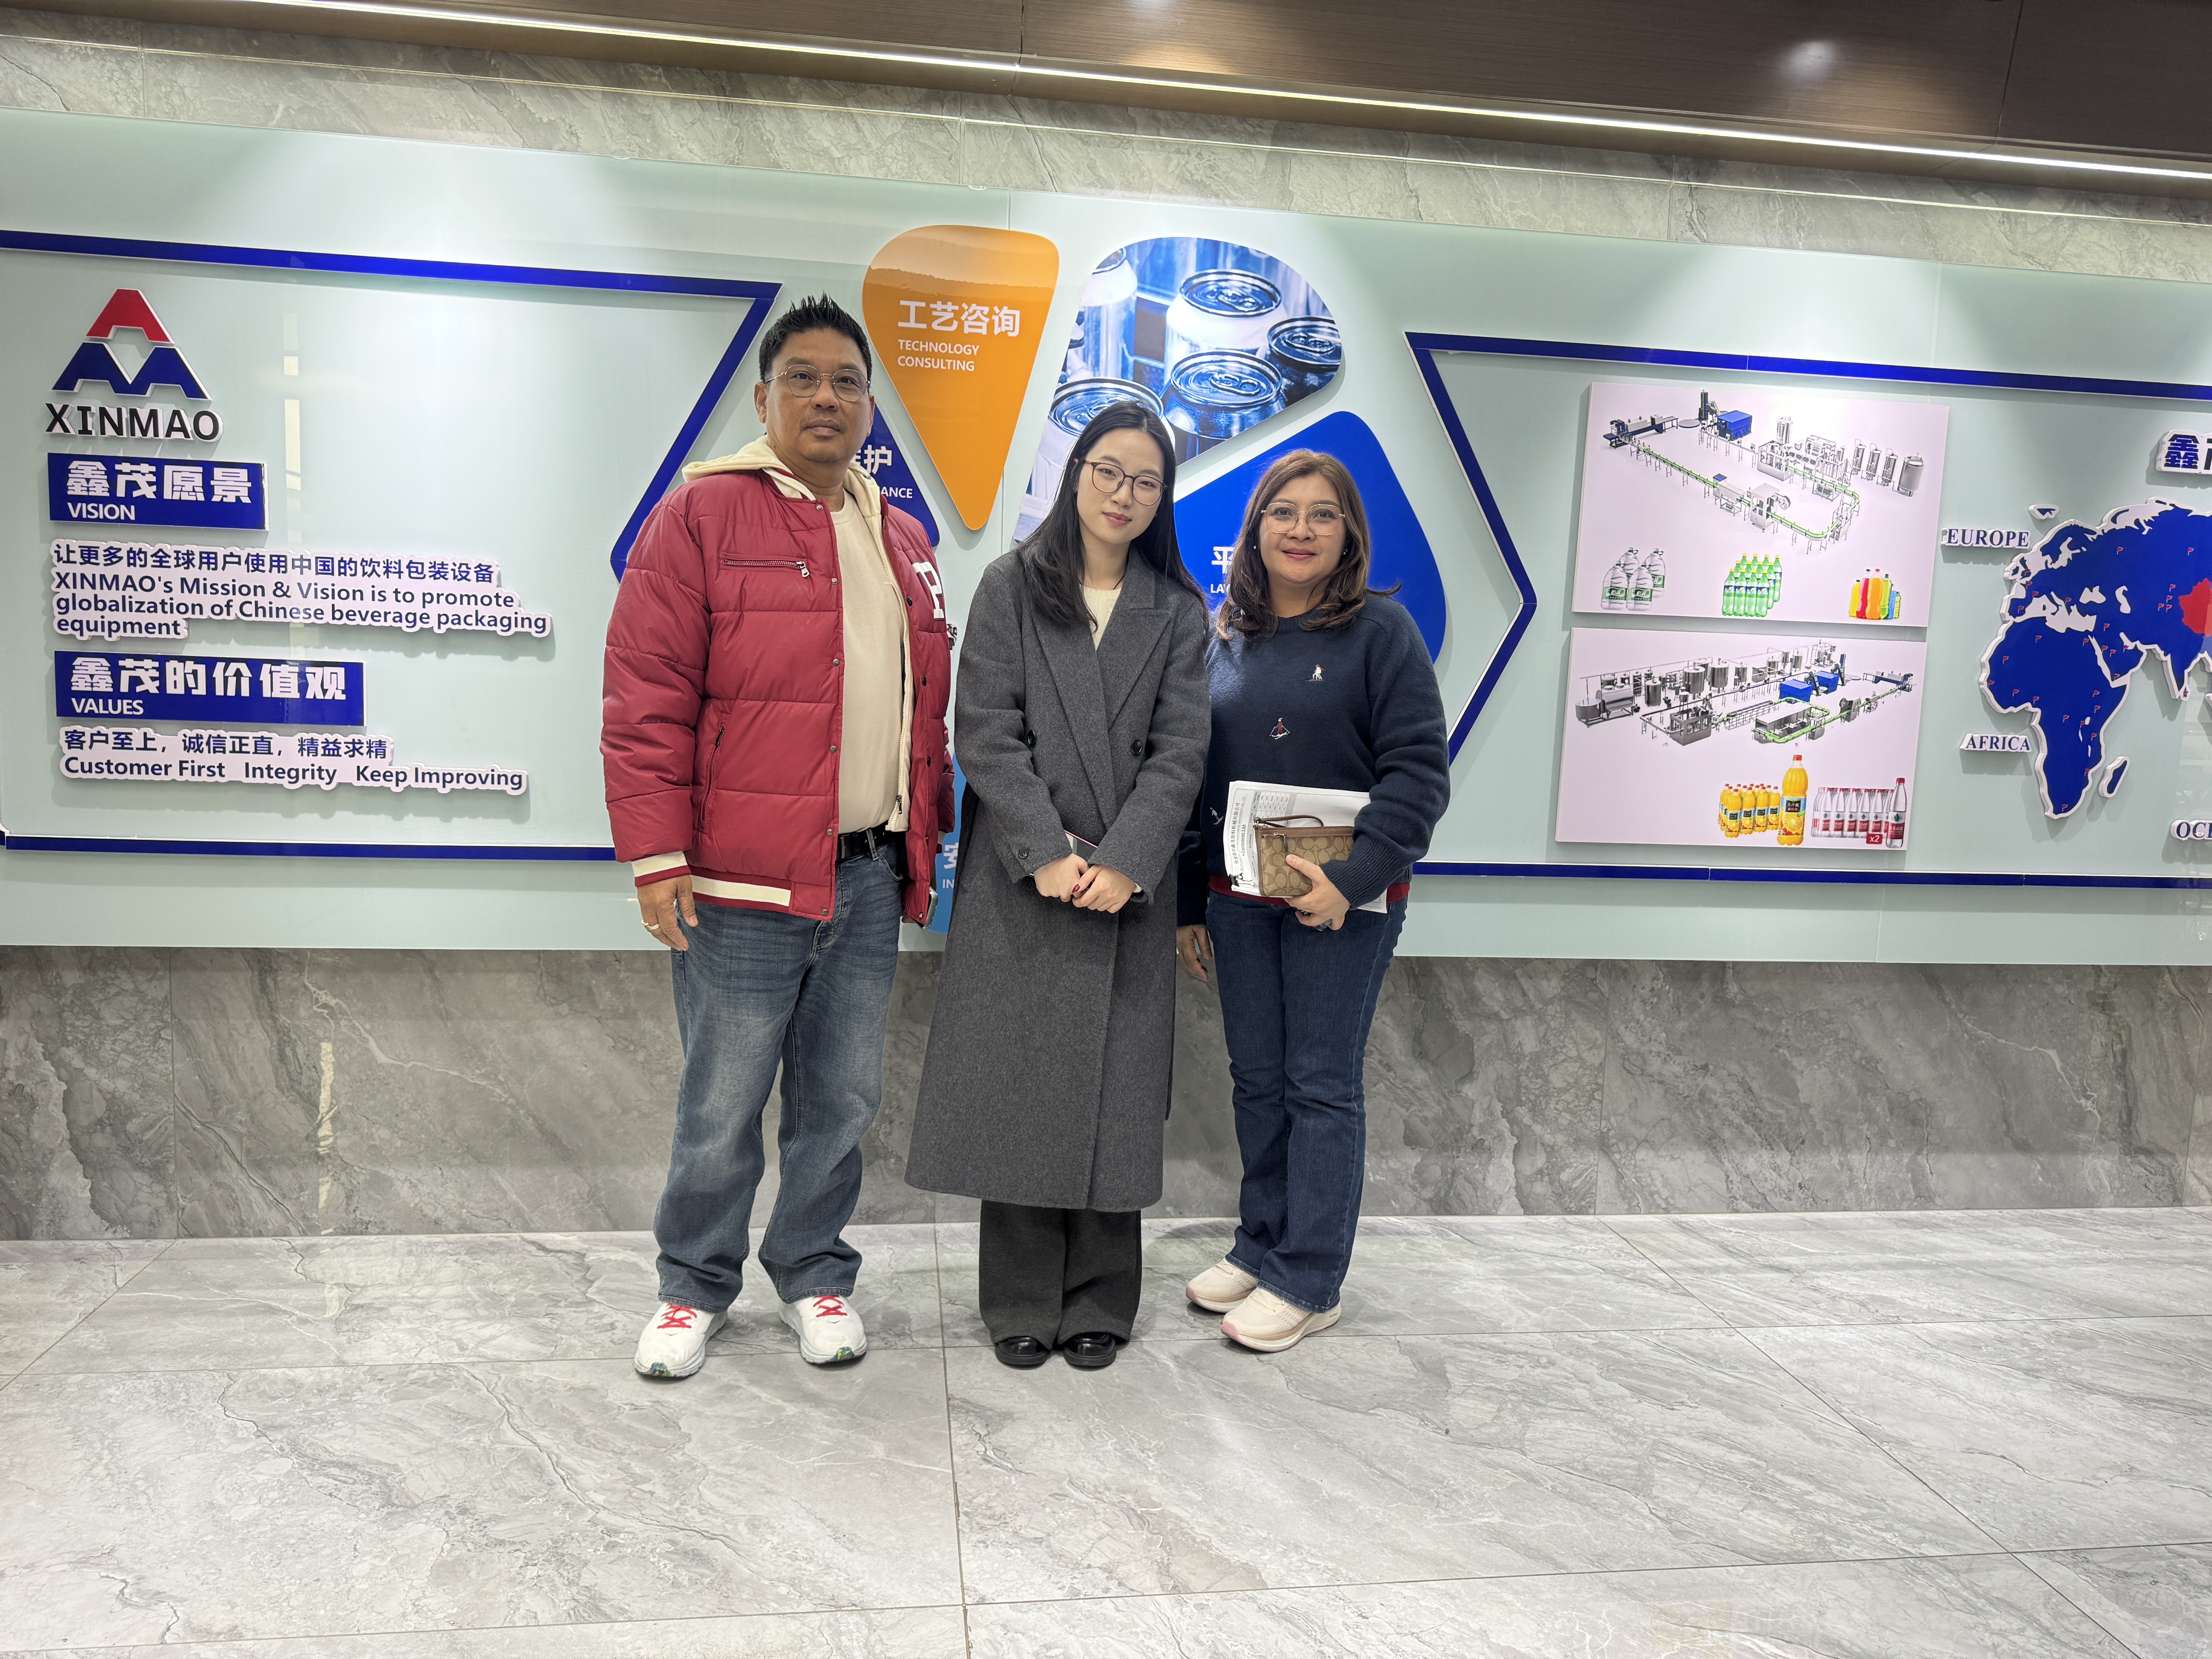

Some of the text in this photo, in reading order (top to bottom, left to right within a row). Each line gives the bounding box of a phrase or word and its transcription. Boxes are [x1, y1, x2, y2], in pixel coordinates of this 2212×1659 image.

[897, 300, 1020, 337] 工艺咨询
[898, 339, 979, 356] TECHNOLOGY
[898, 356, 975, 371] CONSULTING
[45, 403, 220, 441] XINMAO
[2164, 434, 2212, 470] 鑫
[67, 460, 251, 503] 鑫茂愿景
[67, 502, 135, 520] VISION
[1947, 528, 2030, 547] EUROPE
[54, 543, 495, 583] 让更多的全球用户使用中国的饮料包装设备
[55, 572, 514, 608] XINMAO's Mission & Vision is to promote
[1211, 584, 1231, 594] LA
[56, 593, 546, 634] globalization of Chinese beverage packaging
[57, 615, 181, 637] equipment
[70, 657, 347, 700] 鑫茂的价值观
[71, 697, 144, 715] VALUES
[1966, 735, 2030, 751] AFRICA
[64, 756, 523, 790] Customer First Integrity Keep Improving
